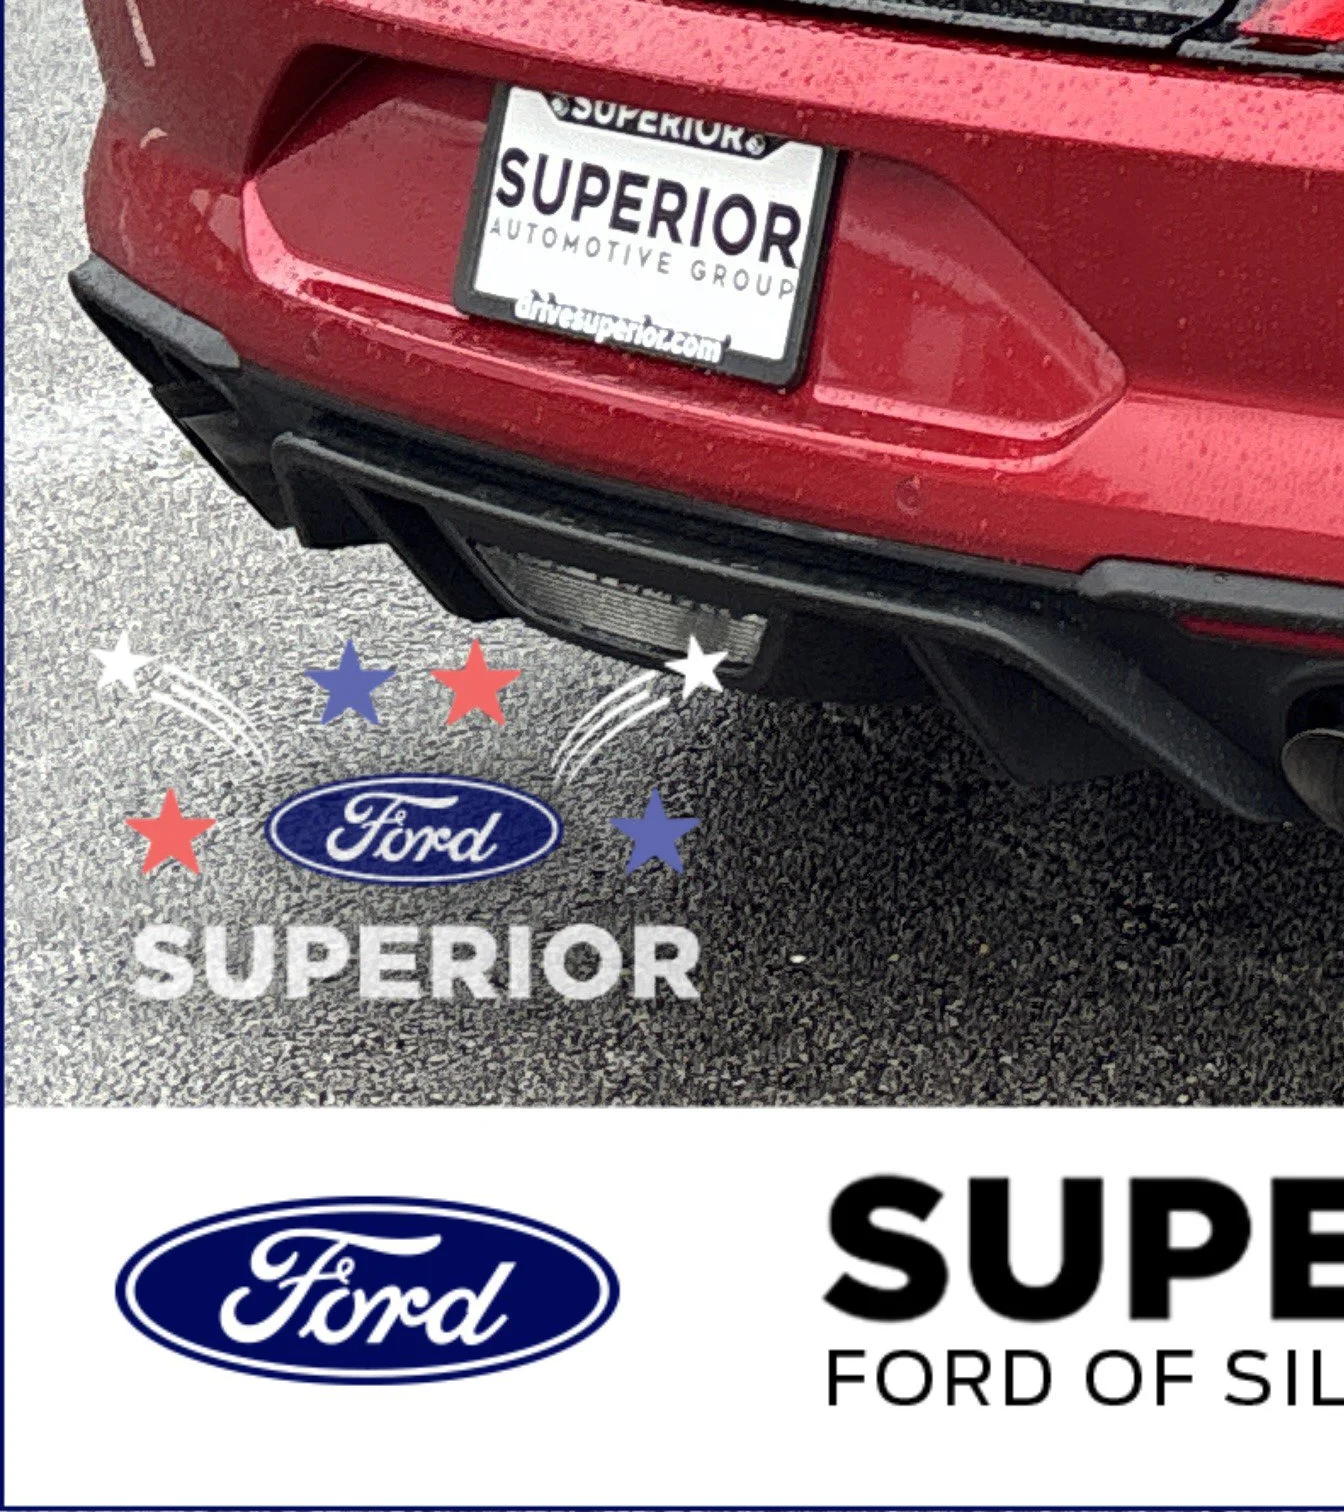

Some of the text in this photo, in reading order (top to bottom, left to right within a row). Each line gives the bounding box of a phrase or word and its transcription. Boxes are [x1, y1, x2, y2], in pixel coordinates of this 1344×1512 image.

[496, 146, 802, 269] SUPERIOR
[489, 216, 796, 301] AUTOMOTIVE GROUP
[514, 289, 724, 364] drivesuperior.com
